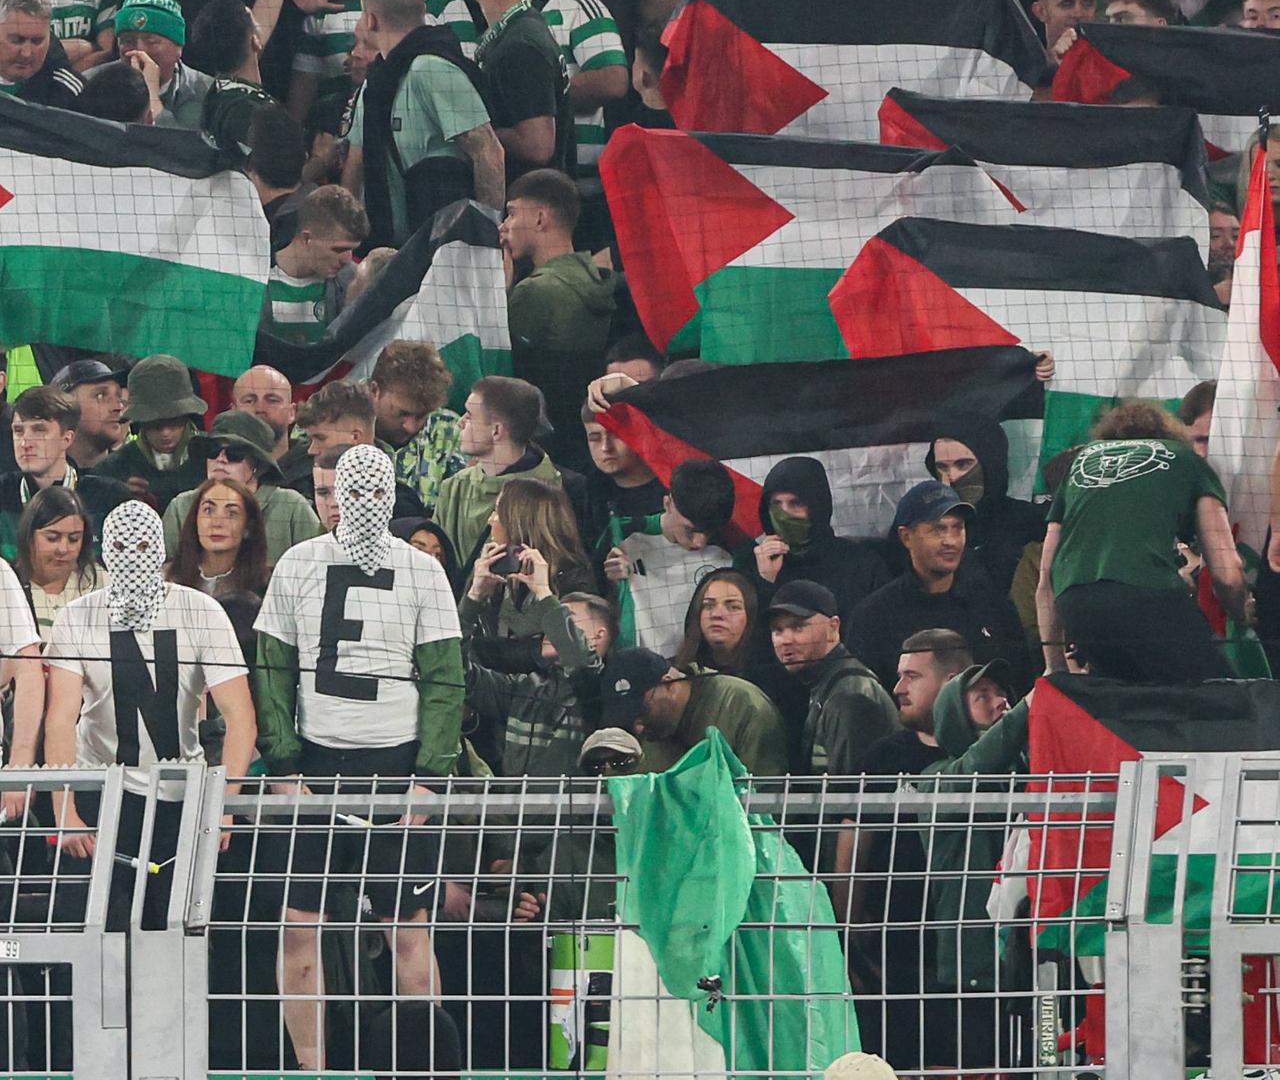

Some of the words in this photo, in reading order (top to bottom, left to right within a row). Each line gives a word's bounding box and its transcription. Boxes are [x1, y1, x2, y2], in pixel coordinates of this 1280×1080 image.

[110, 629, 180, 767] N
[315, 565, 394, 700] E
[1041, 994, 1055, 1052] ULTRAS
